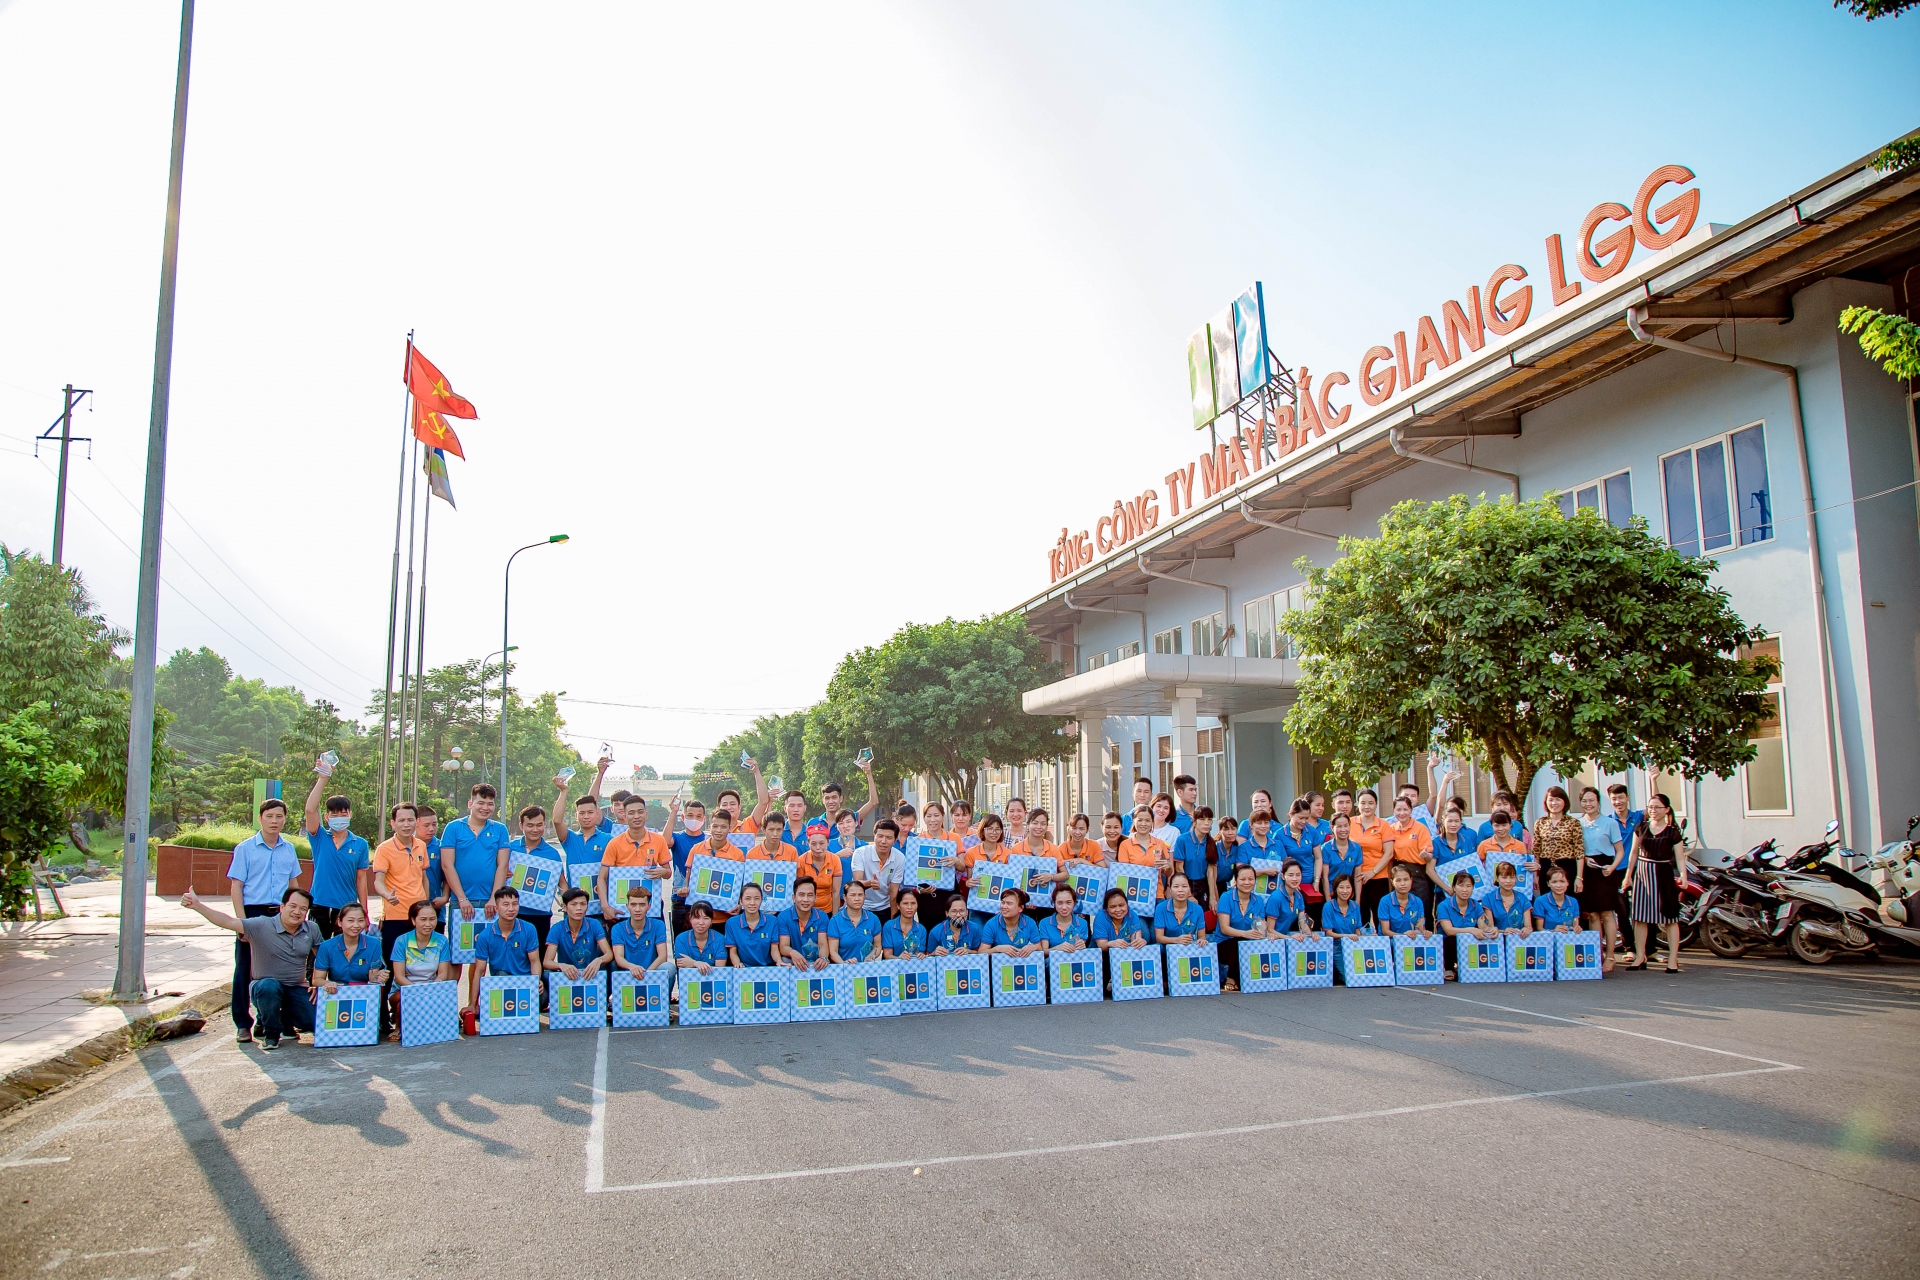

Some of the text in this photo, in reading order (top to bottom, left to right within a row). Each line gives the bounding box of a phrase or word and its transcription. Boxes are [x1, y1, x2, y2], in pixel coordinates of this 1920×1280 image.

[1048, 164, 1700, 583] TỔNG CÔNG TY MAY BẮC GIANG LGG
[925, 847, 937, 877] LGG
[514, 873, 546, 889] LGG
[701, 877, 731, 892] LGG
[754, 880, 785, 893] GG
[1258, 878, 1277, 890] LG
[1355, 957, 1385, 969] LGG
[1404, 953, 1436, 966] LGG
[1470, 951, 1499, 963] LGG
[1518, 954, 1546, 965] LGG
[1567, 951, 1594, 963] LGG
[1252, 963, 1279, 974] LGG
[1298, 960, 1326, 971] LGG
[1062, 971, 1094, 983] LGG
[1123, 970, 1154, 981] LGG
[1181, 966, 1212, 978] LGG
[948, 979, 980, 990] LGG
[1004, 974, 1037, 986] LGG
[857, 986, 890, 999] LGG
[899, 983, 928, 994] GG
[624, 995, 659, 1007] LGG
[690, 991, 726, 1003] LGG
[743, 991, 778, 1004] LGG
[800, 989, 834, 1001] LGG
[493, 999, 529, 1012] LGG
[561, 996, 597, 1008] LGG
[326, 1010, 365, 1023] LGG
